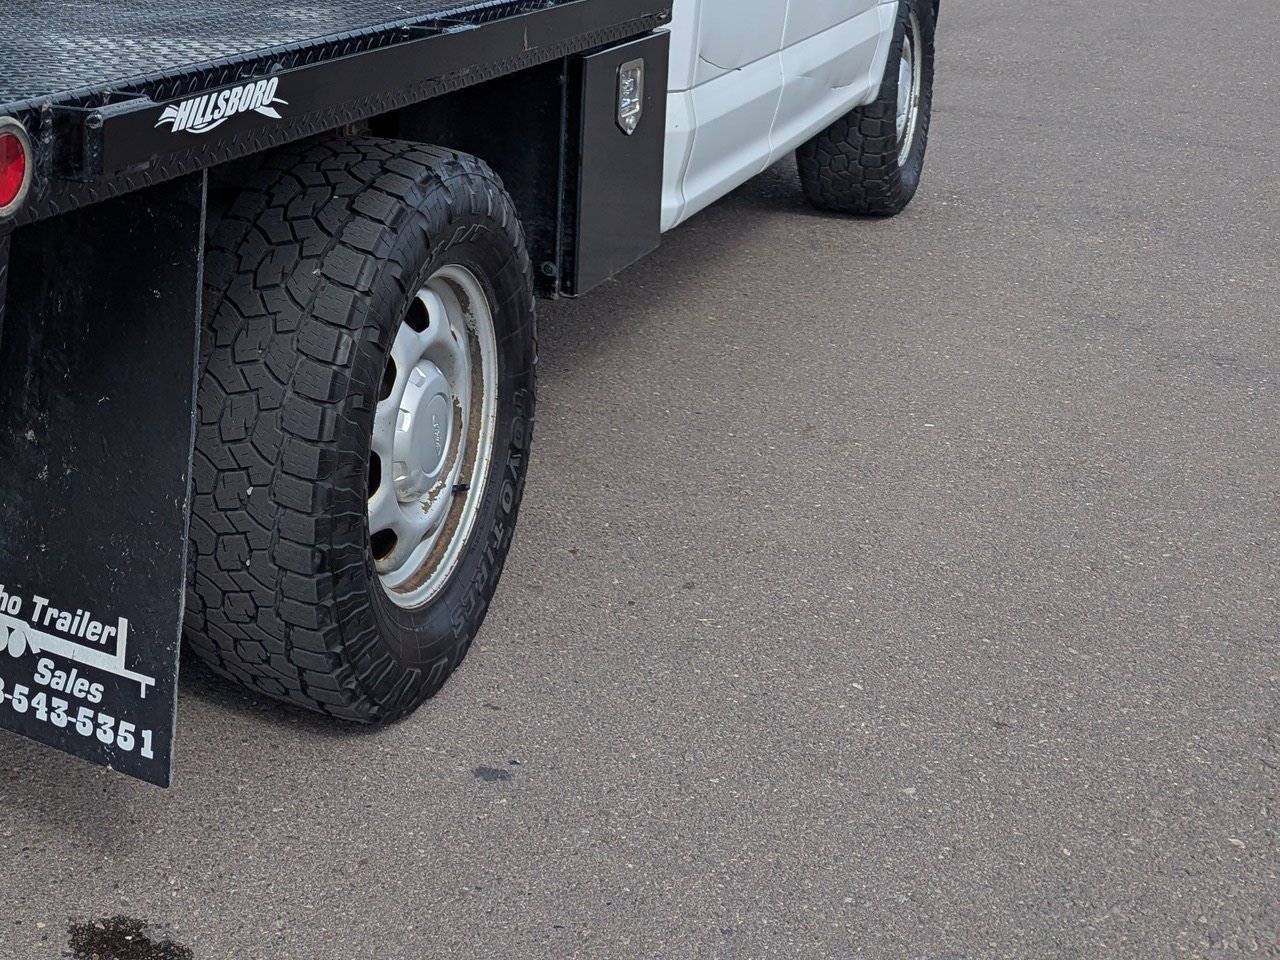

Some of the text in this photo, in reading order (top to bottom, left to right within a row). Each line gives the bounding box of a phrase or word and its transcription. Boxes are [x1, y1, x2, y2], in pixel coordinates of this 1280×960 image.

[171, 76, 279, 133] HILLSBORO
[31, 595, 117, 645] Trailer
[33, 657, 105, 704] Sales
